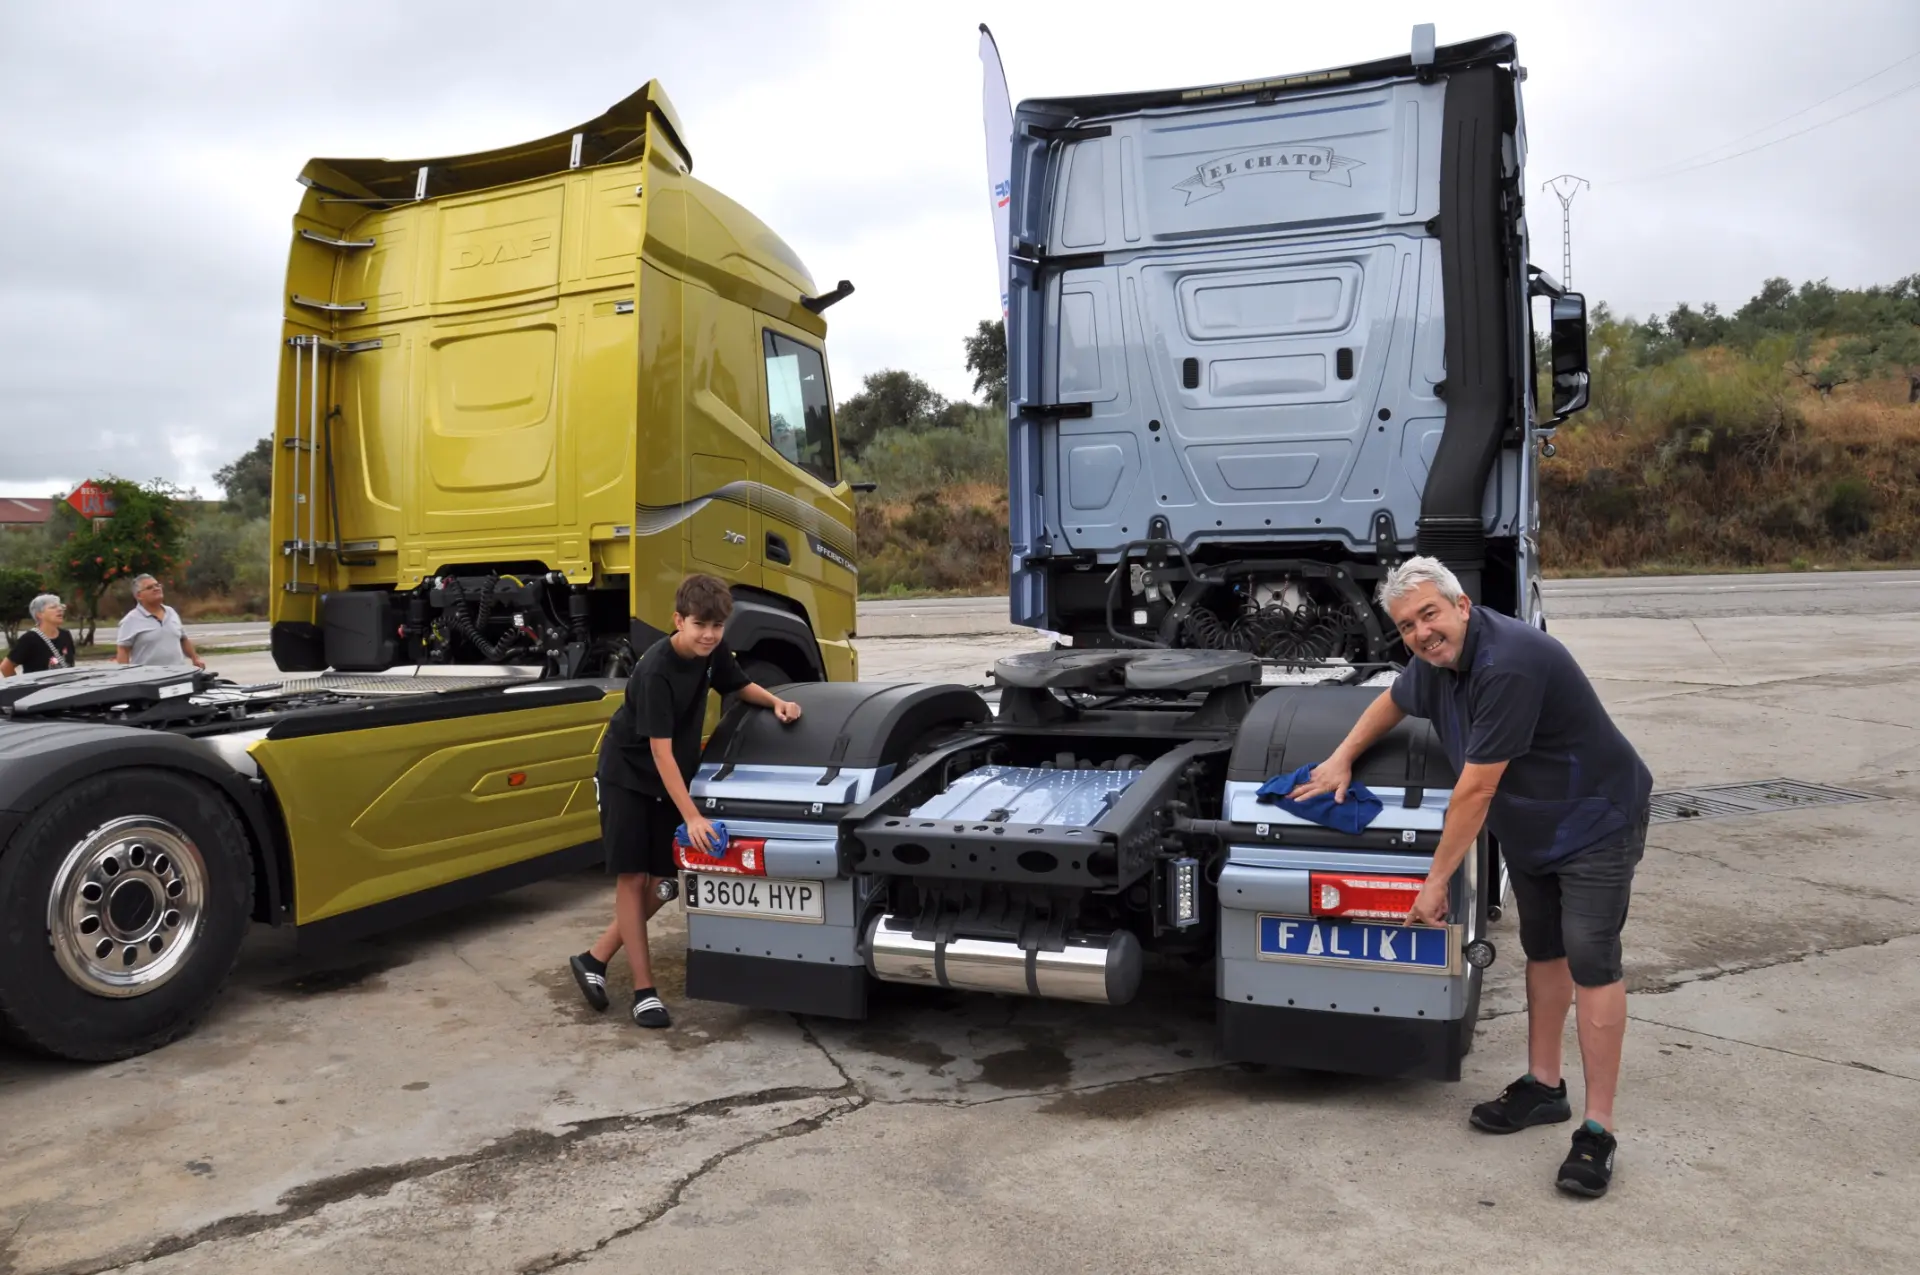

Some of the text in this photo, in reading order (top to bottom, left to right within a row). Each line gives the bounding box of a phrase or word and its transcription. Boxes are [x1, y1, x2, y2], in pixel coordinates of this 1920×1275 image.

[1210, 153, 1322, 179] EL CHATO
[449, 231, 551, 271] DAF
[704, 880, 812, 911] 3604 HYP
[1278, 922, 1417, 961] FALIKI
